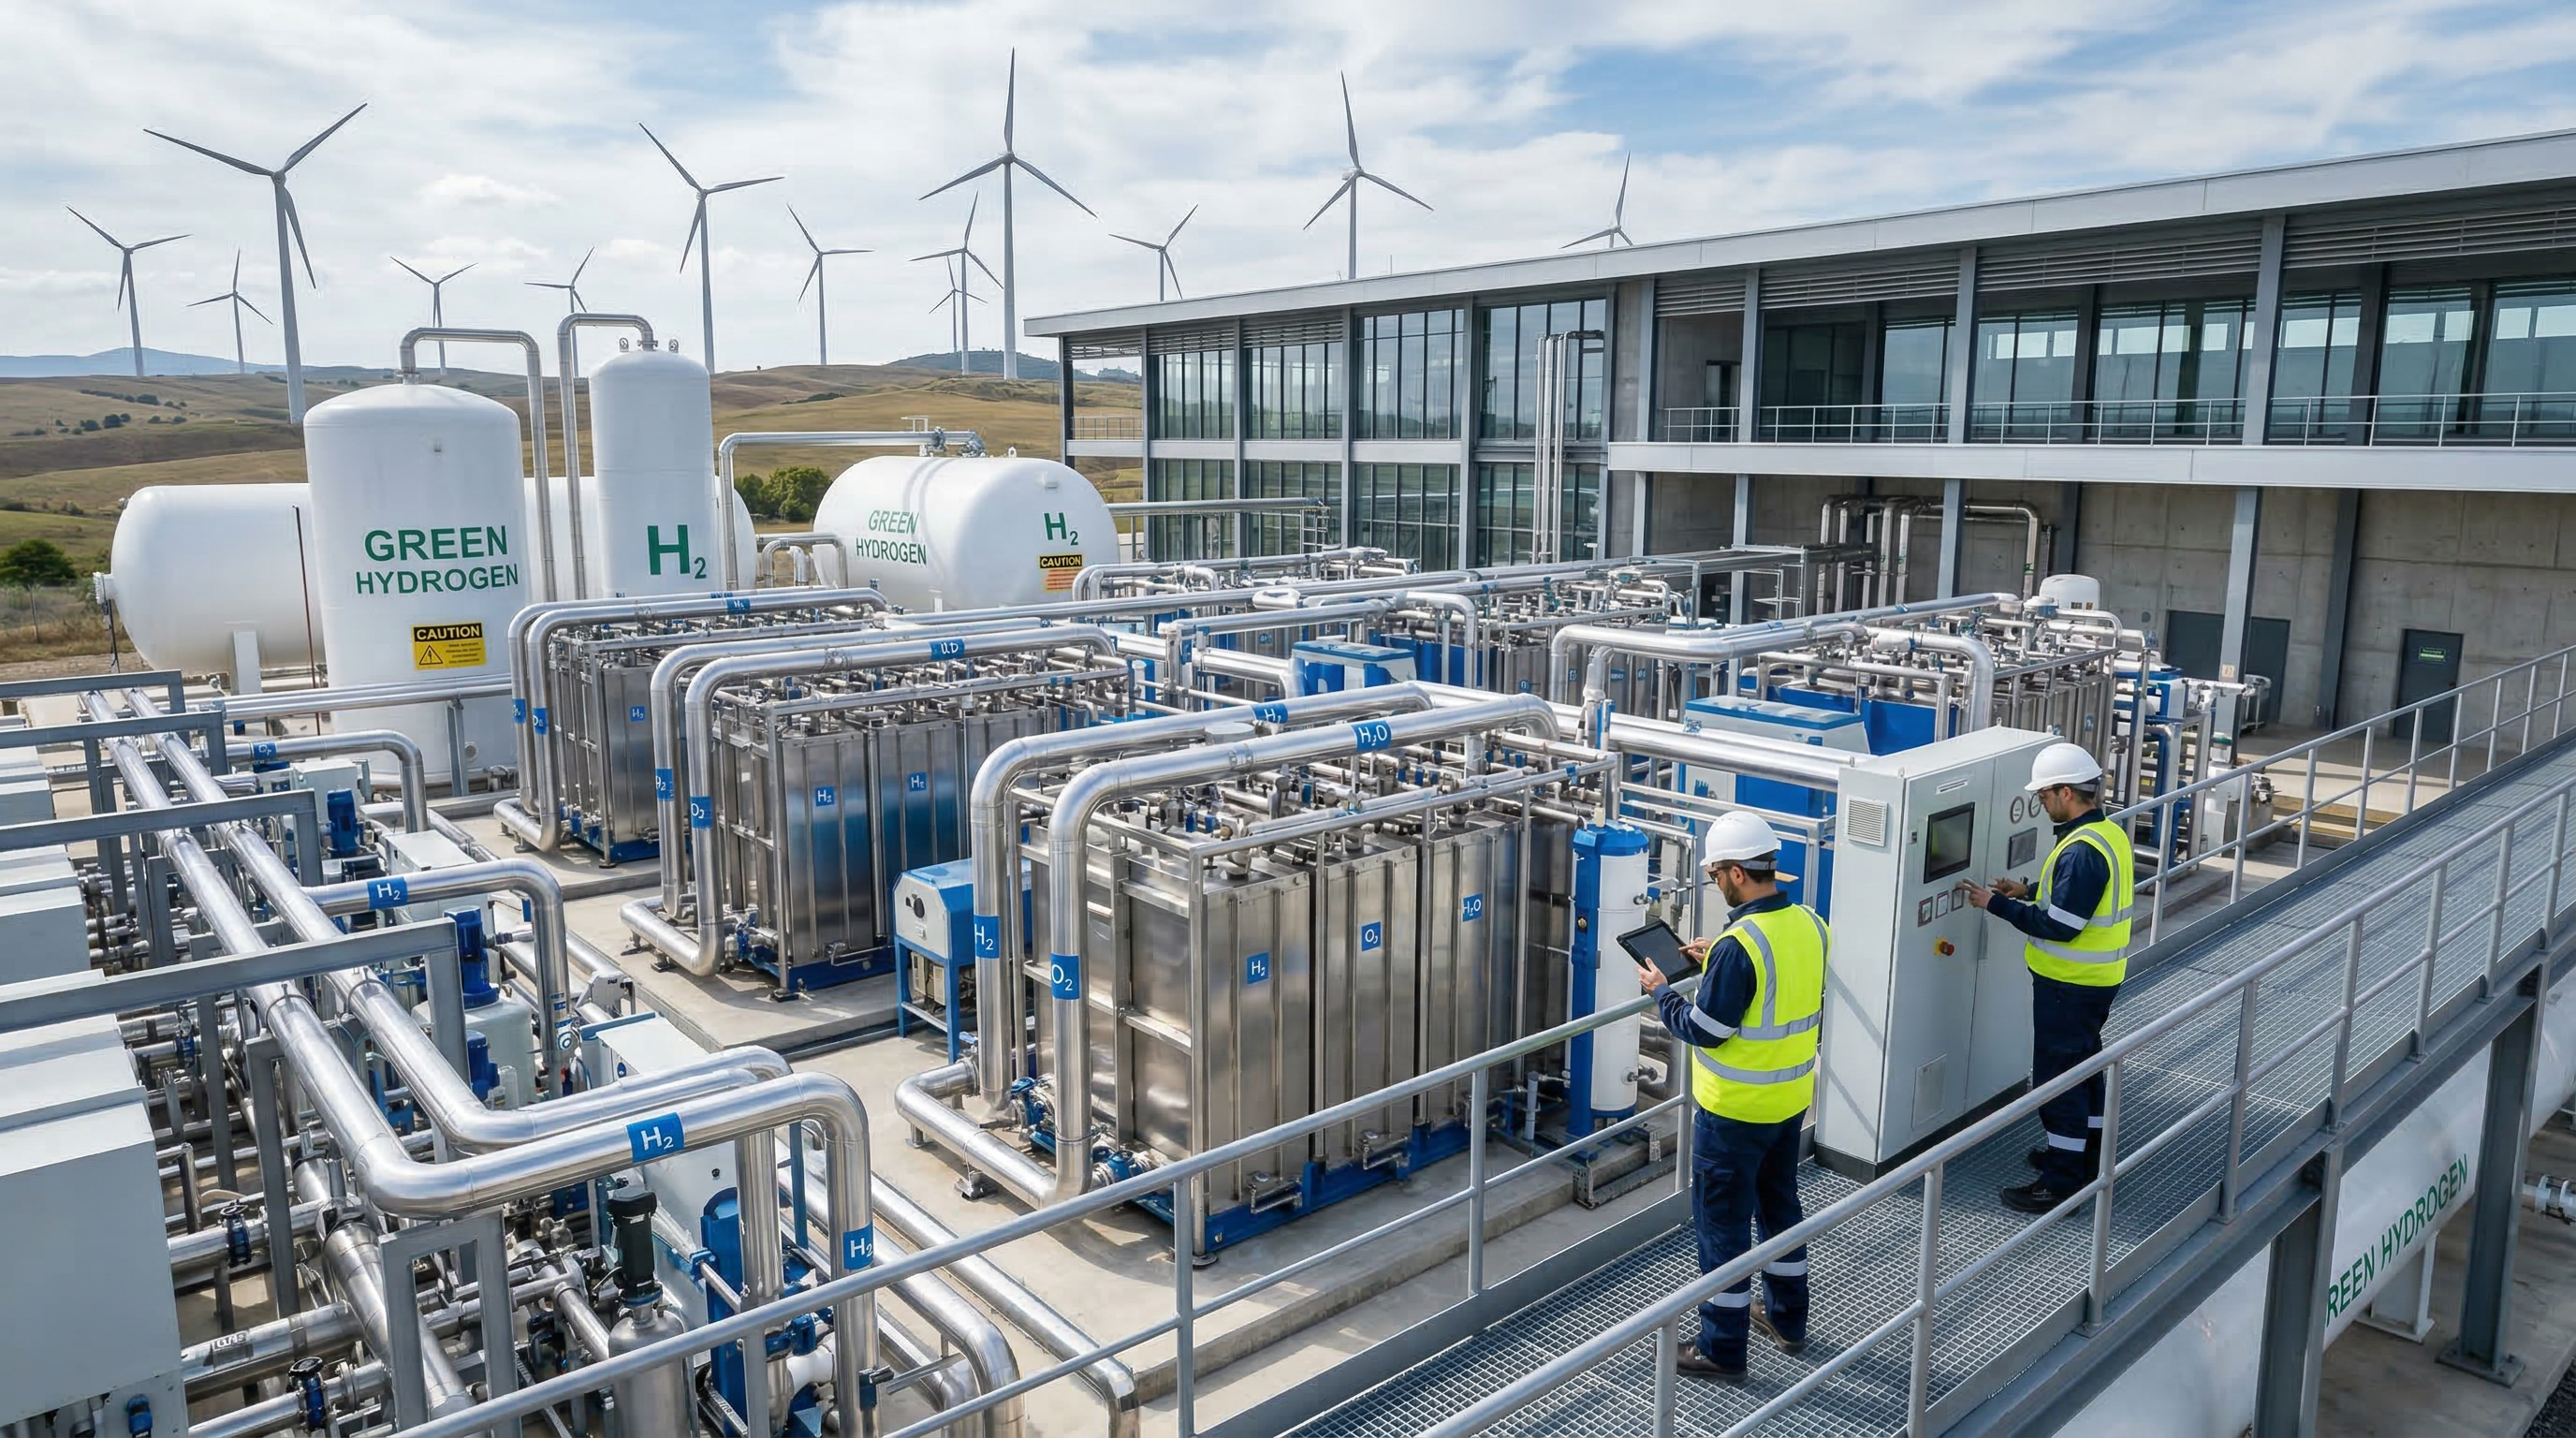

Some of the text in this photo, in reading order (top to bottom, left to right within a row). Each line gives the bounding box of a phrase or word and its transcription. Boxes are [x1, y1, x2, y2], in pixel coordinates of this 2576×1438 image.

[869, 510, 919, 535] GREEN
[1043, 512, 1079, 546] H2
[364, 525, 508, 562] GREEN
[648, 524, 707, 580] H2
[856, 537, 927, 565] HYDROGEN
[1041, 556, 1081, 567] CAUTION
[356, 564, 519, 594] HYDROGEN
[417, 625, 480, 640] CAUTION
[817, 789, 832, 802] H2
[376, 883, 401, 901] H2
[974, 923, 994, 950] H2
[1051, 964, 1073, 991] O2
[640, 1126, 674, 1151] H2
[850, 1238, 873, 1258] H2
[2326, 1153, 2467, 1328] REEN HYDROGEN
